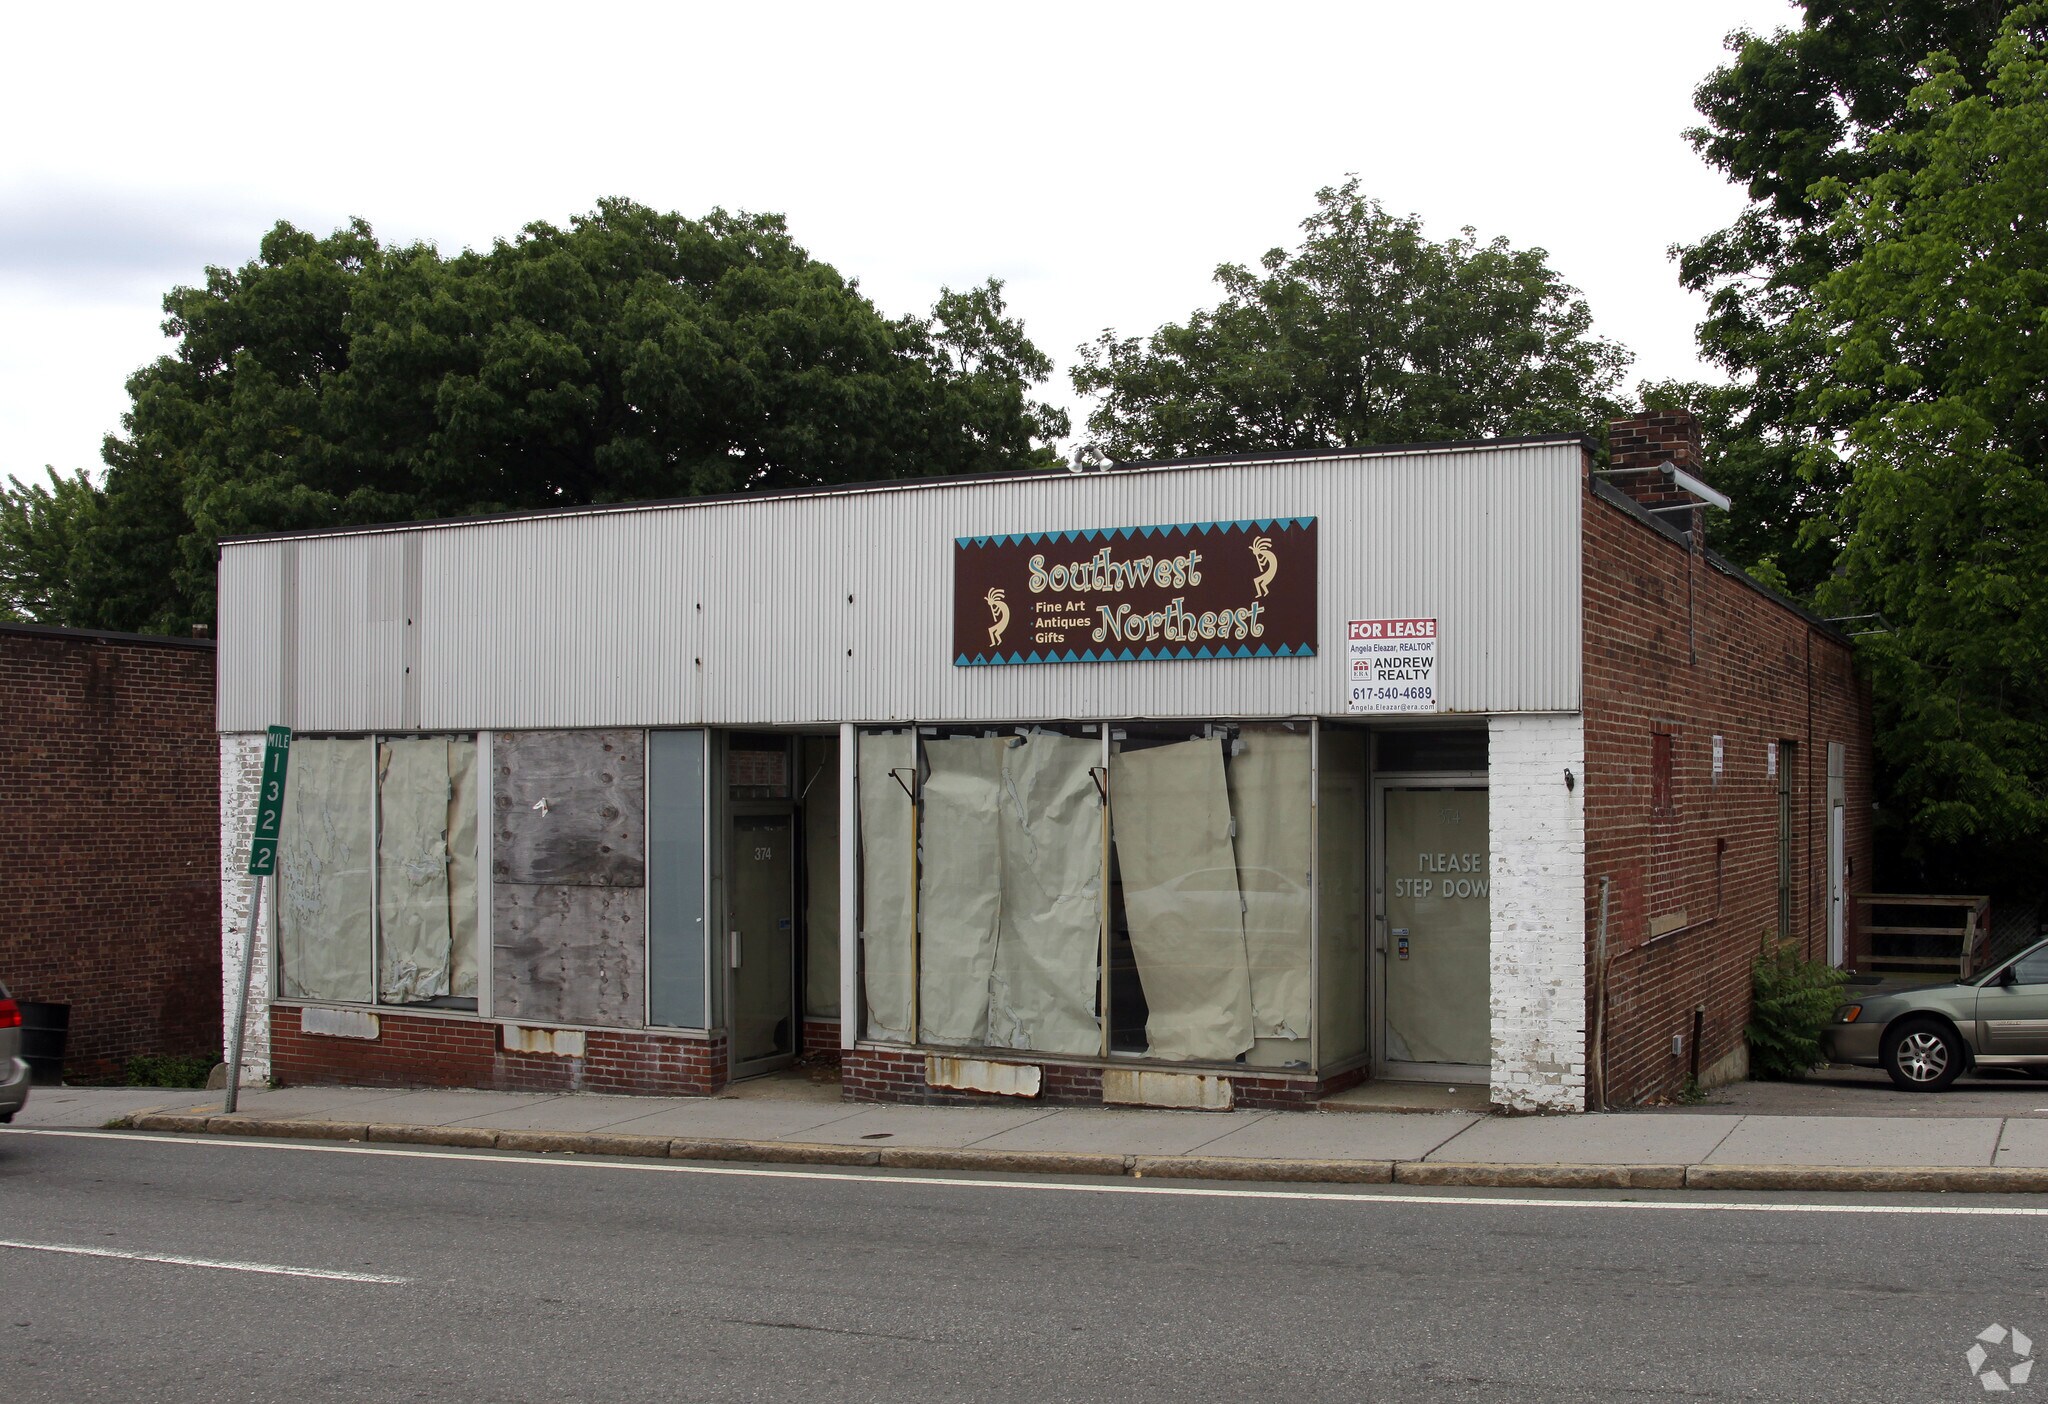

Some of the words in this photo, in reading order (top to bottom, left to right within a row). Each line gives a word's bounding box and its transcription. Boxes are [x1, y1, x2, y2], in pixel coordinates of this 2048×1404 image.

[1028, 547, 1202, 593] Southwest
[1036, 602, 1062, 613] Fine
[1065, 601, 1086, 612] Art
[1035, 616, 1091, 630] Antiques
[1091, 597, 1265, 642] Northeast
[1350, 622, 1382, 638] FOR
[1387, 621, 1435, 637] LEASE
[1035, 632, 1065, 643] Gifts
[1350, 644, 1372, 654] Angela
[1374, 657, 1434, 668] ANDREW
[1378, 669, 1430, 680] REALTY
[1353, 686, 1432, 700] 617-540-4689
[268, 732, 290, 749] MILE
[754, 847, 772, 861] 374
[1395, 878, 1433, 898] STEP
[1442, 878, 1490, 898] DOW
